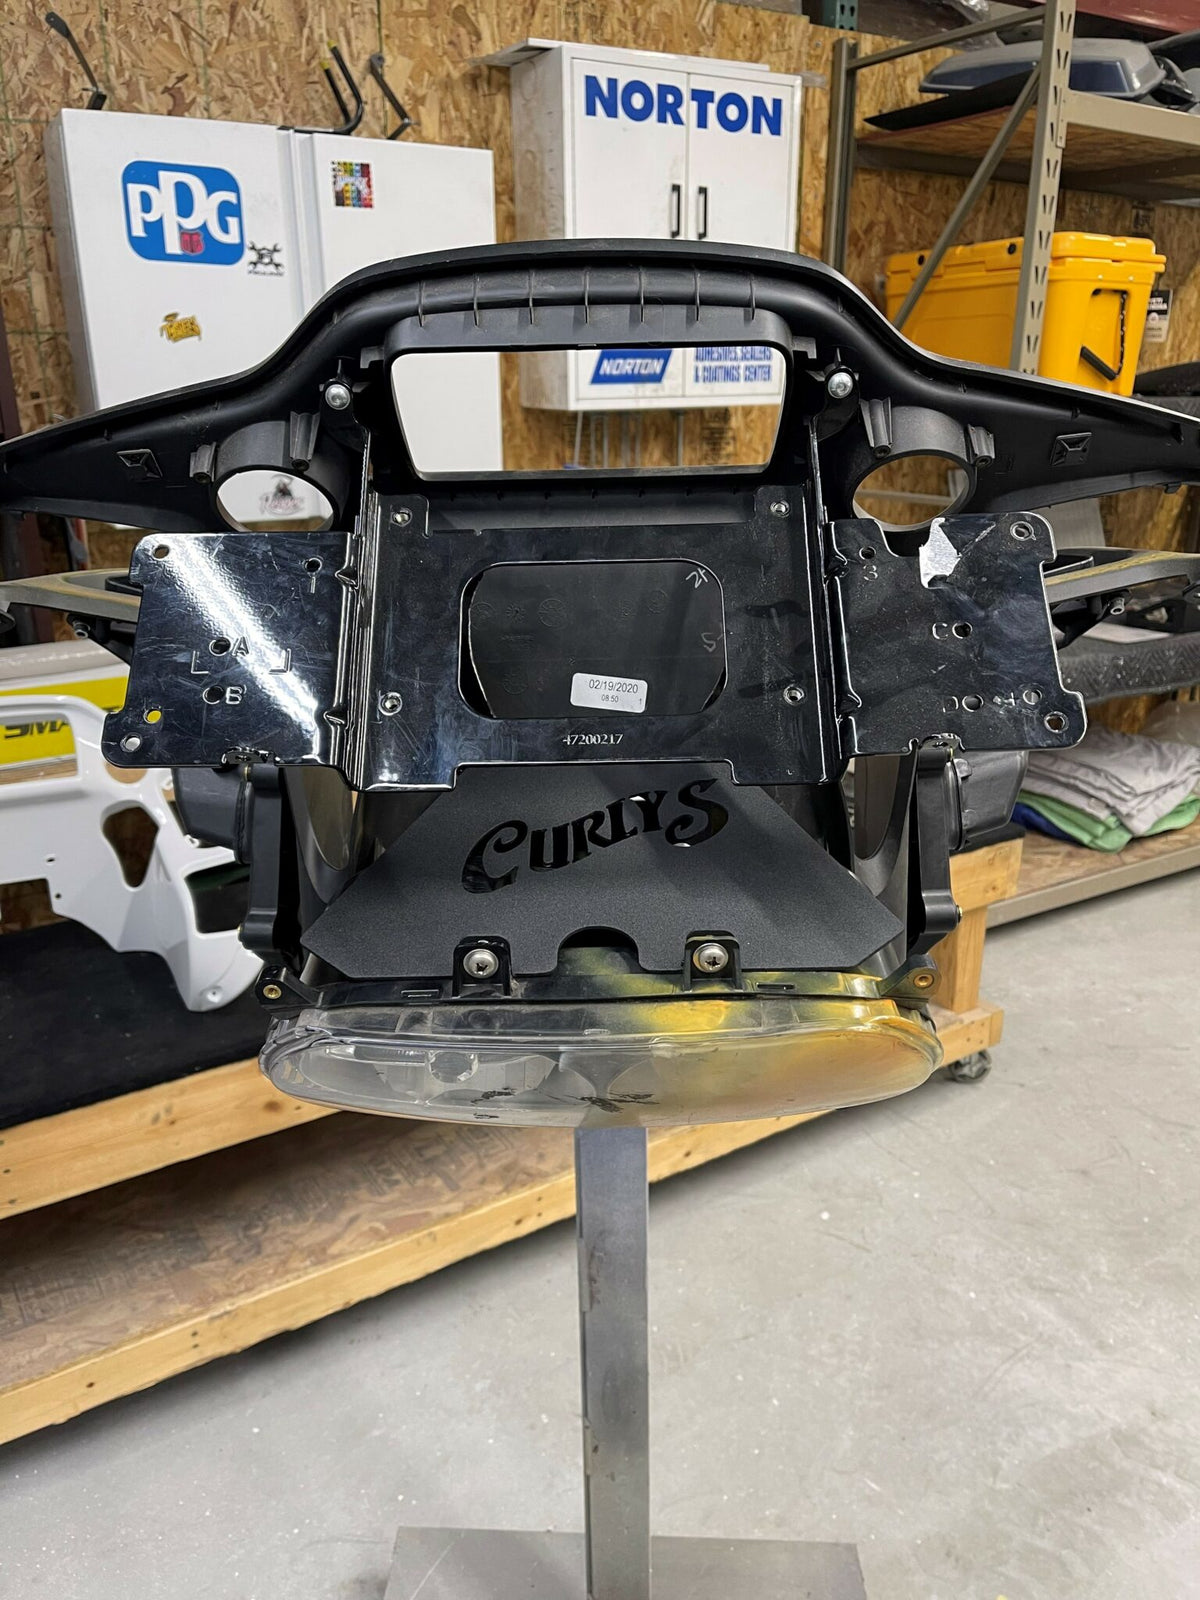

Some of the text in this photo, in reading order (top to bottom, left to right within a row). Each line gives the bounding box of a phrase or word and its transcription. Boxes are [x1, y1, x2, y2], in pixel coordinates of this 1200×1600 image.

[585, 75, 782, 136] NORTON
[126, 170, 241, 255] PPG
[599, 358, 664, 376] NORTON
[703, 365, 740, 382] COATINGS
[744, 365, 771, 382] CENTER
[232, 636, 250, 656] A
[225, 686, 247, 704] B
[588, 679, 639, 694] 02/19/2020
[562, 733, 624, 746] 47200217
